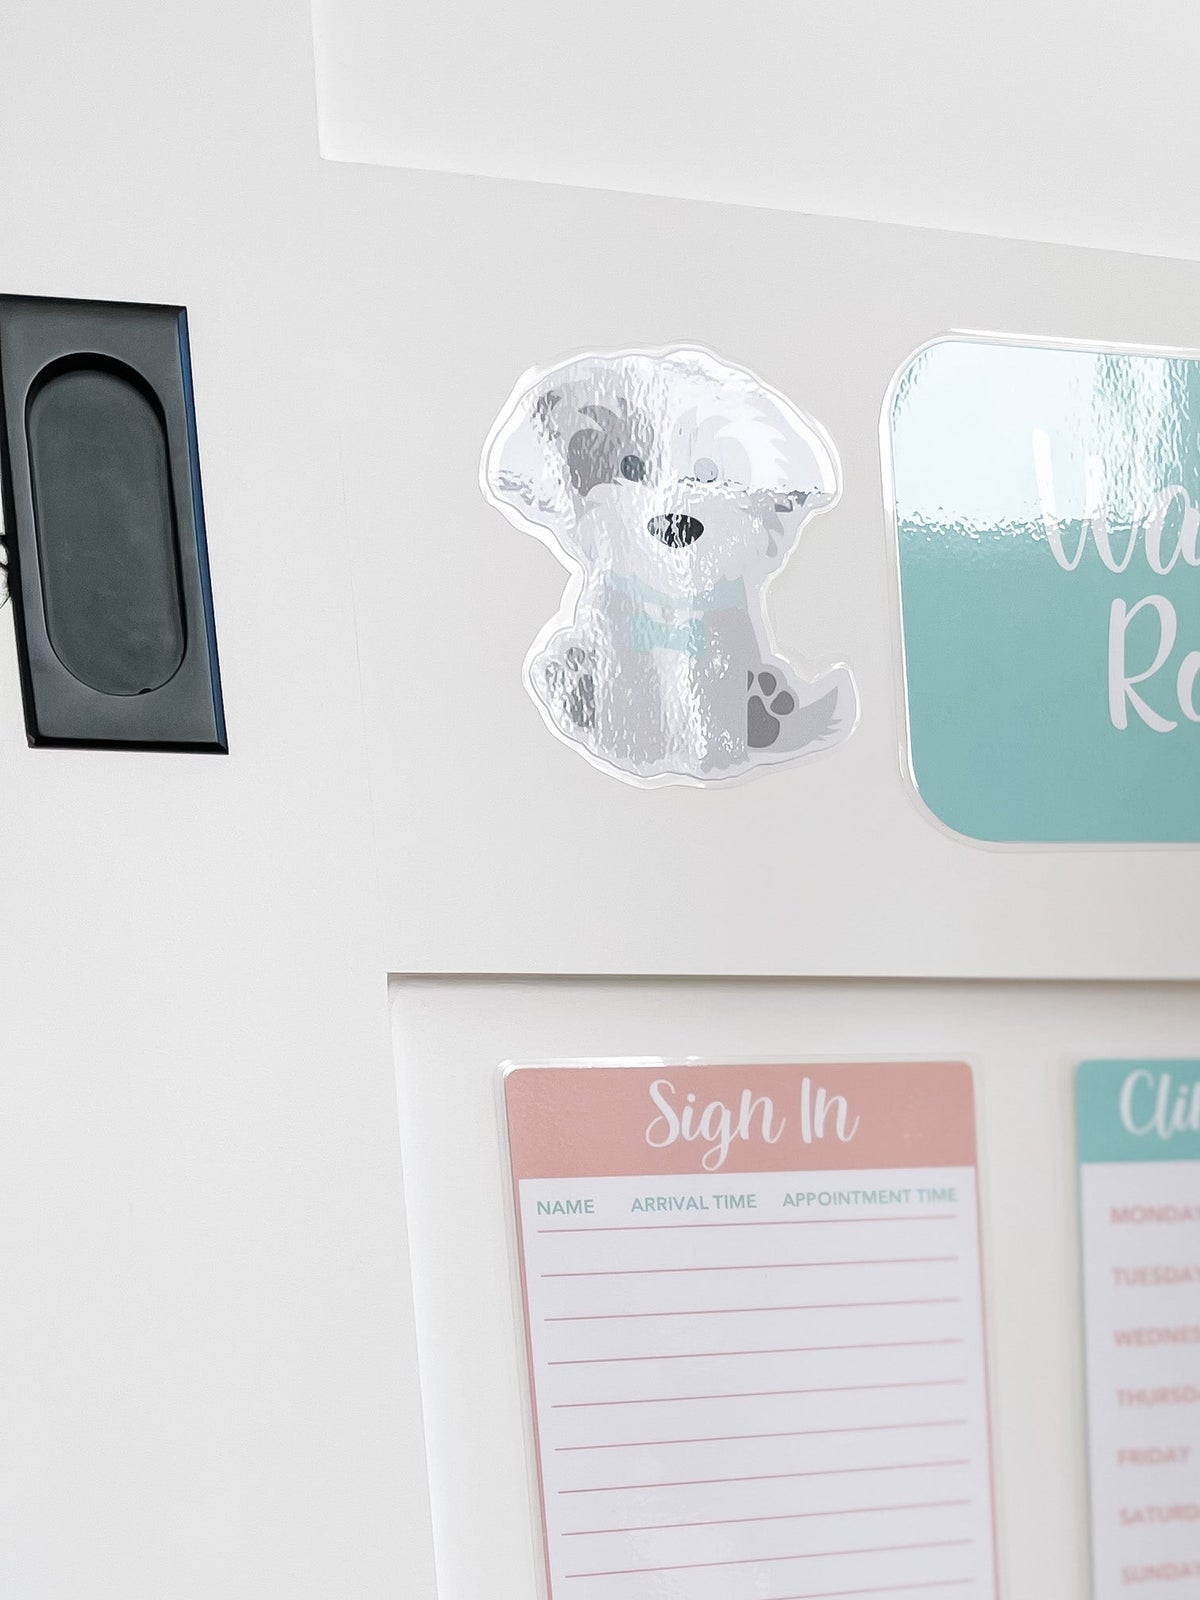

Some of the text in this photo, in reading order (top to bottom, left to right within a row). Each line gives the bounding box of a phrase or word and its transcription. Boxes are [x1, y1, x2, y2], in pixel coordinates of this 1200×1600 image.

[645, 1076, 861, 1171] Sign In
[536, 1186, 958, 1216] NAME ARRIVAL TIME APPOINTMENT TIME
[1117, 1445, 1192, 1467] FRIDAY
